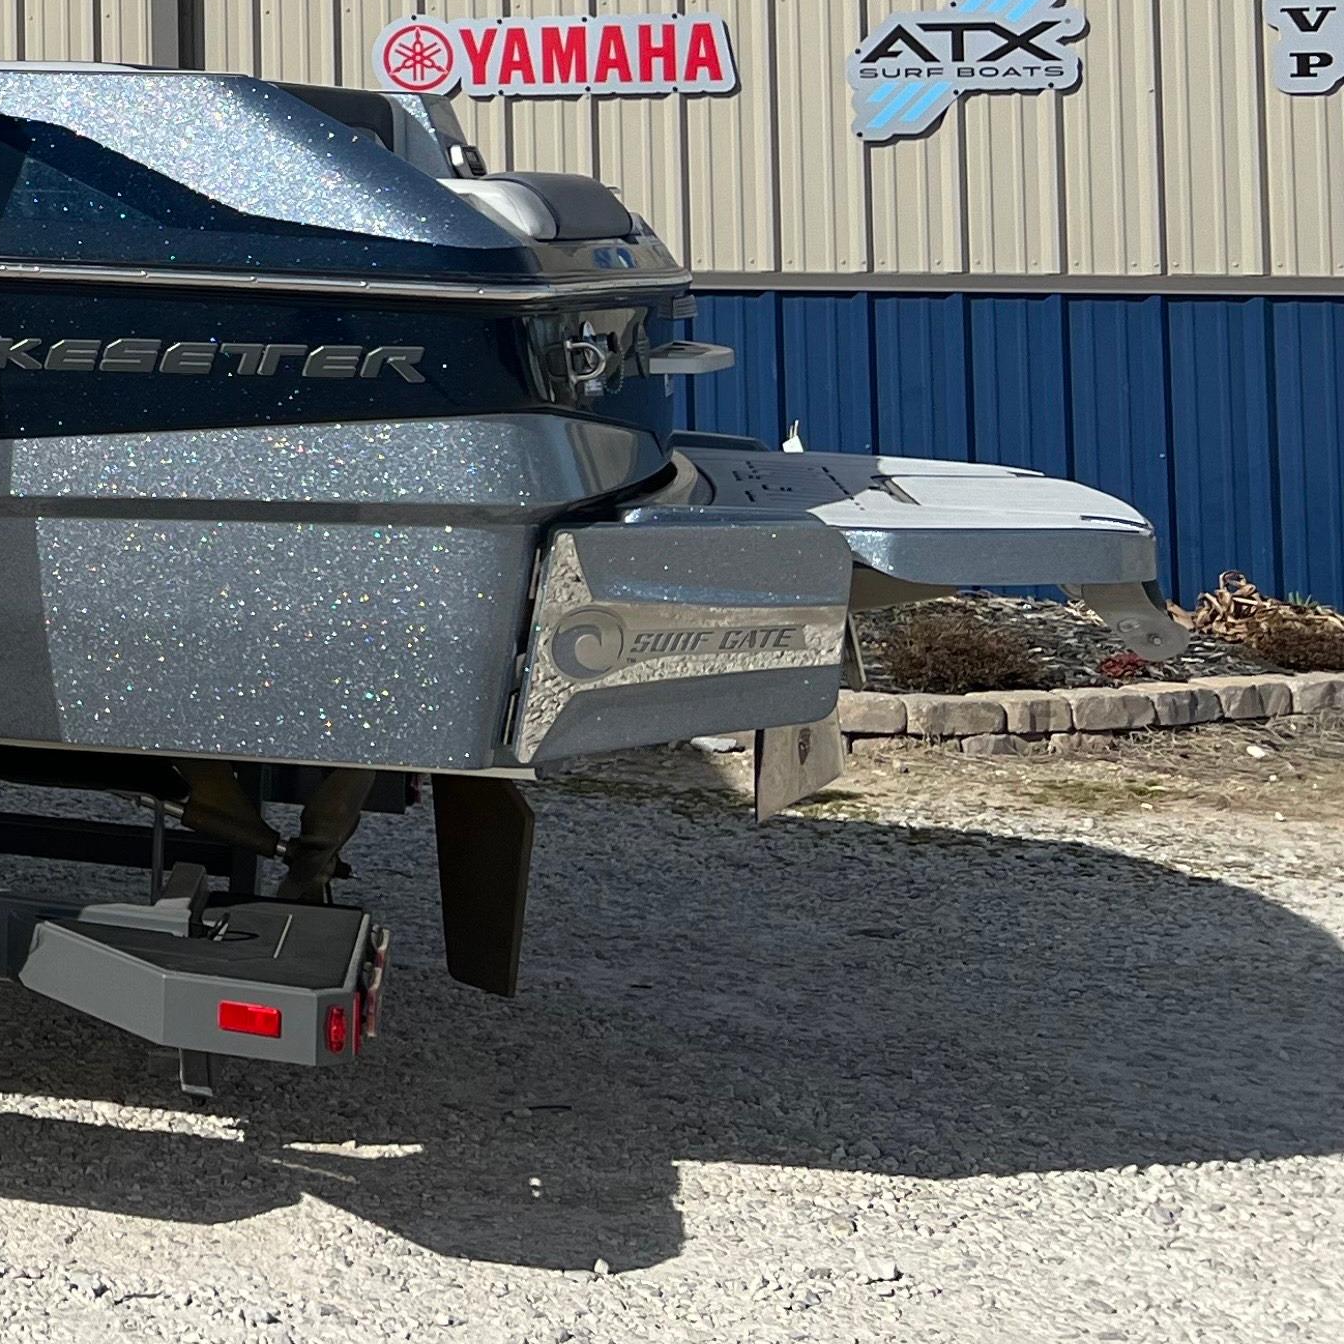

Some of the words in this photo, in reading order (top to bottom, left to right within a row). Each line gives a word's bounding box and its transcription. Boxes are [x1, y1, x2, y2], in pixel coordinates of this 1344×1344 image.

[1280, 6, 1337, 32] V
[459, 23, 724, 85] YAMAHA
[860, 20, 1063, 63] ATX
[859, 67, 944, 79] SURF
[957, 66, 1064, 78] BOATS
[1289, 52, 1334, 78] P
[719, 628, 797, 650] GATE
